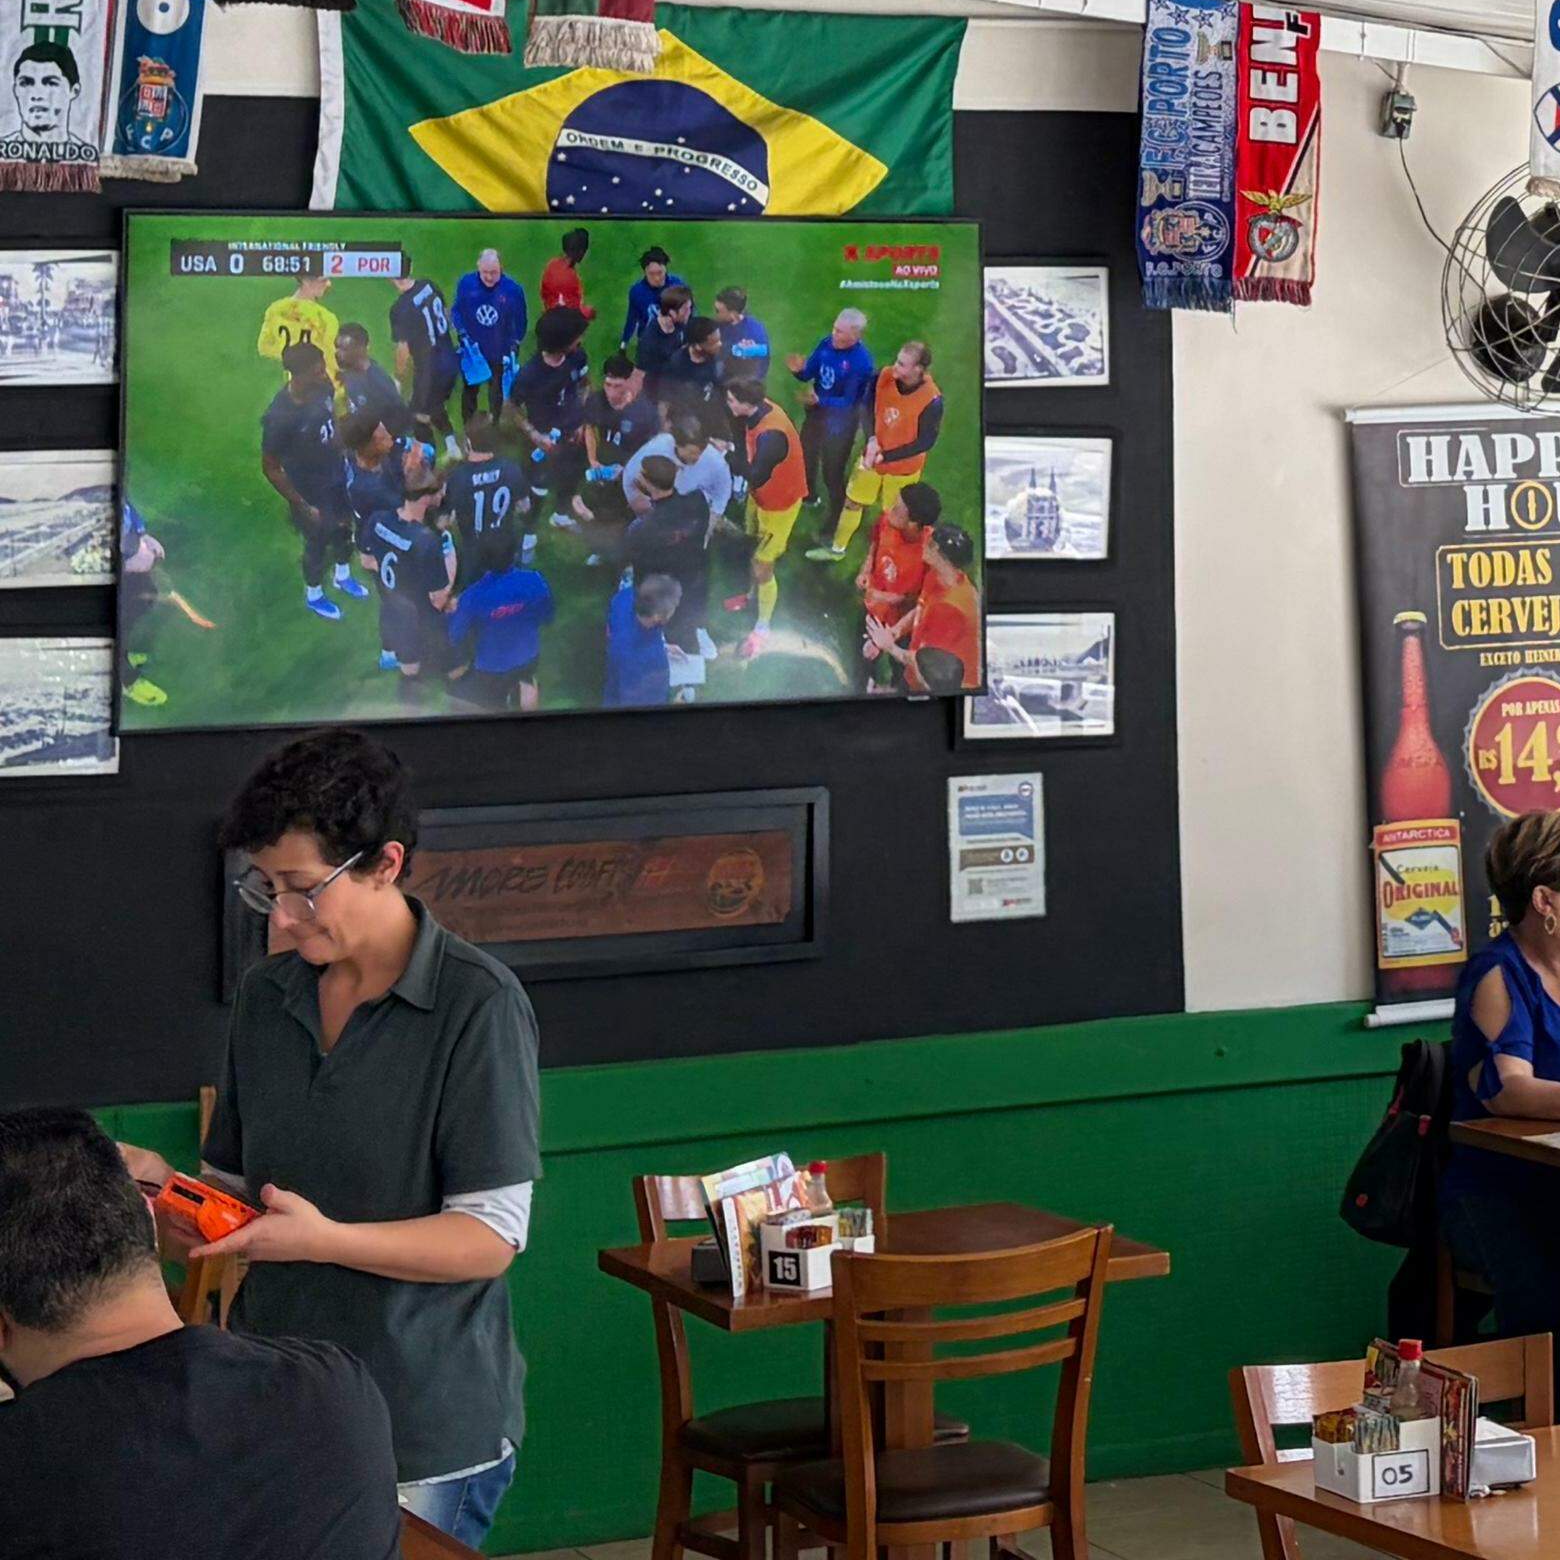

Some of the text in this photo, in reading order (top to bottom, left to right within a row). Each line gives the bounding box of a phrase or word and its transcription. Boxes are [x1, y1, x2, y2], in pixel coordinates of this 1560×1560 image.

[1145, 26, 1192, 117] PORTO
[566, 131, 625, 152] ORDEM
[653, 145, 759, 191] PROGRESSO
[180, 254, 391, 274] USA 0 68:51 2 POR
[912, 265, 938, 276] VIVO
[473, 485, 512, 533] 19
[380, 551, 398, 590] 6
[1446, 547, 1553, 590] TODAS
[1501, 701, 1523, 718] POR
[1382, 827, 1451, 842] ANTARCTICA
[1382, 880, 1460, 909] ORIGINAL
[772, 1256, 798, 1282] 15
[1381, 1463, 1414, 1487] 05
